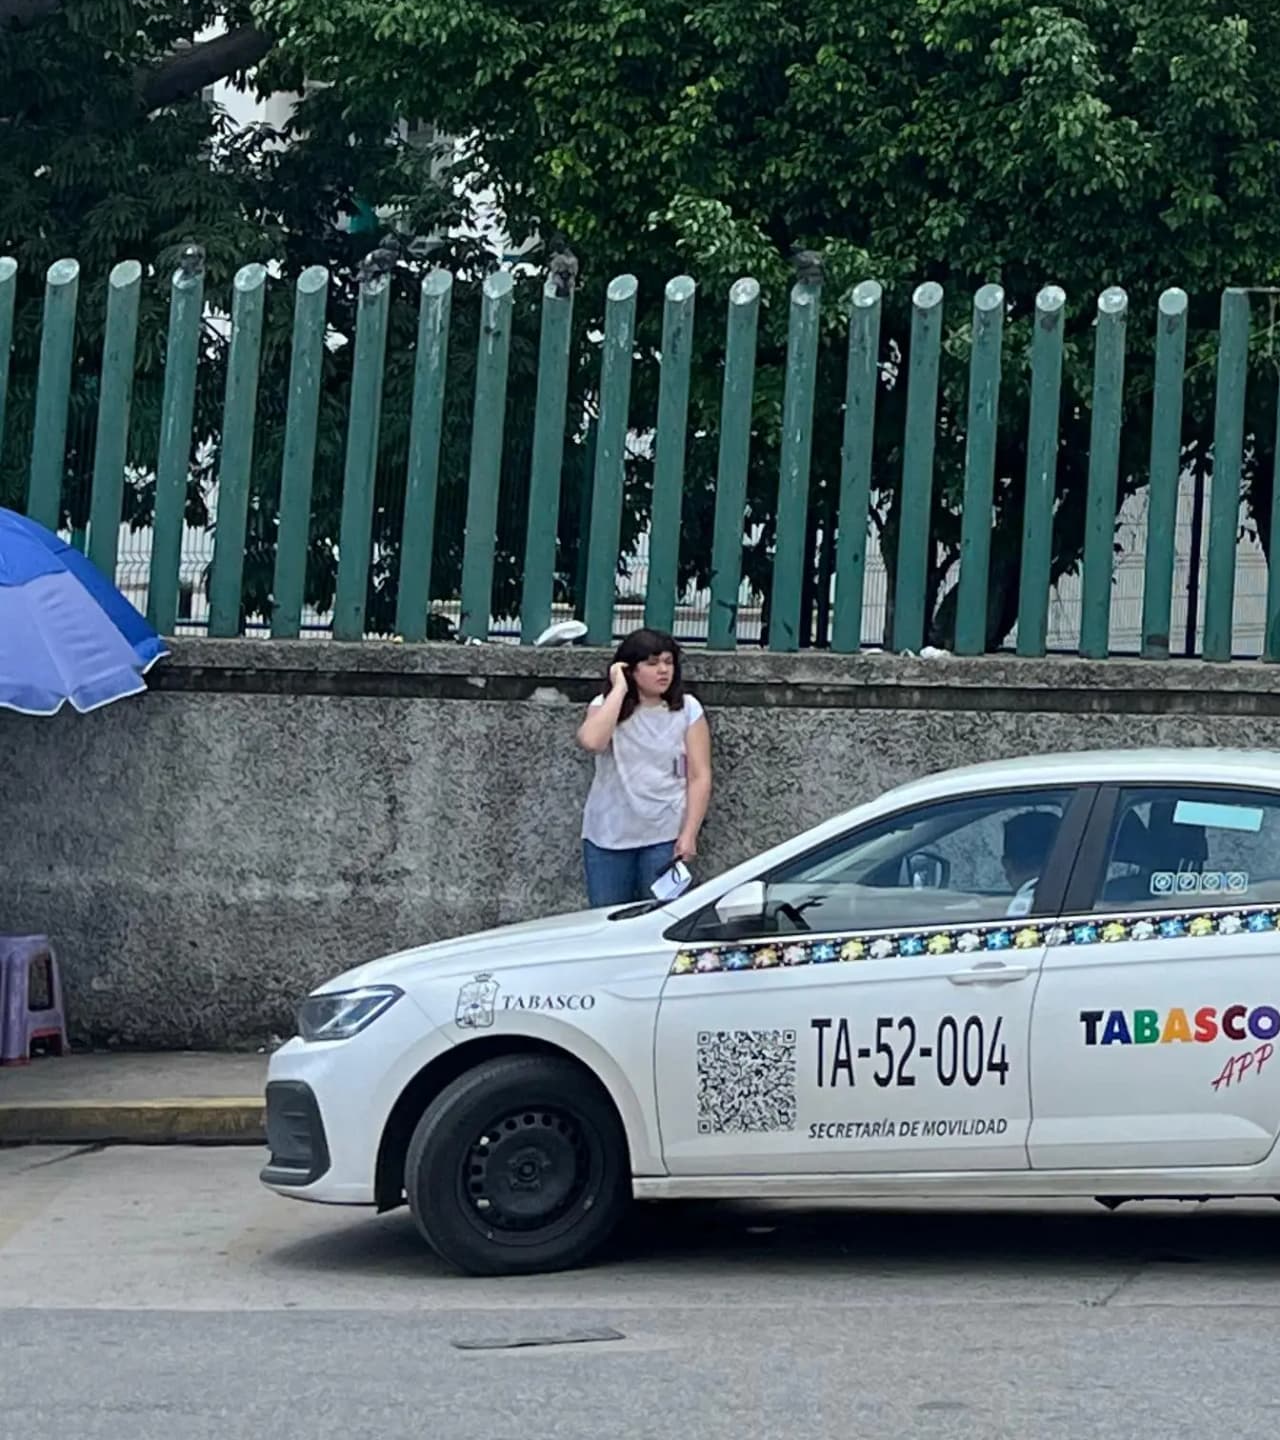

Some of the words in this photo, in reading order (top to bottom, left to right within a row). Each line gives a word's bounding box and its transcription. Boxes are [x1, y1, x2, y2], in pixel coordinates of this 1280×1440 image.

[502, 994, 595, 1010] TABASCO
[810, 1015, 1009, 1088] TA-52-004
[1211, 1042, 1274, 1092] APP
[808, 1118, 895, 1139] SECRETARÍA
[899, 1120, 920, 1137] DE
[921, 1118, 1008, 1137] MOVILIDAD
